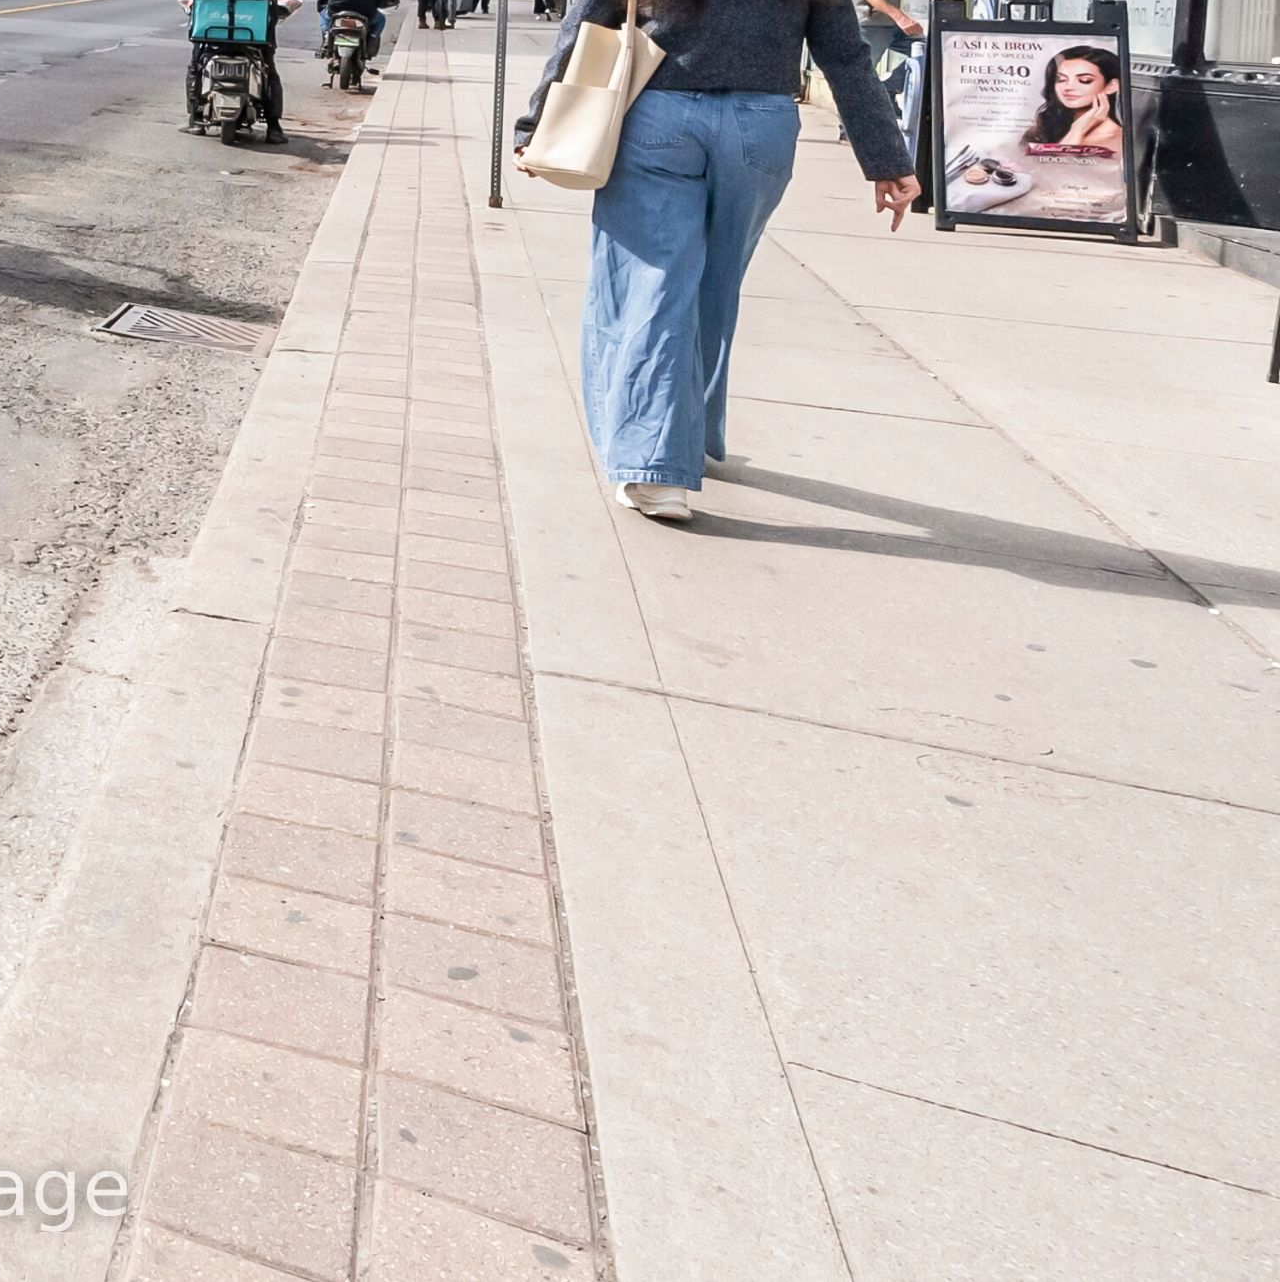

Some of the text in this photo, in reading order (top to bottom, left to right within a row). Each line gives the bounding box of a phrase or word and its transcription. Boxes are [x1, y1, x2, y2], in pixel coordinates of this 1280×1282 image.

[953, 41, 988, 51] LASH
[1004, 41, 1043, 51] BROW
[960, 64, 1031, 78] FREE $40
